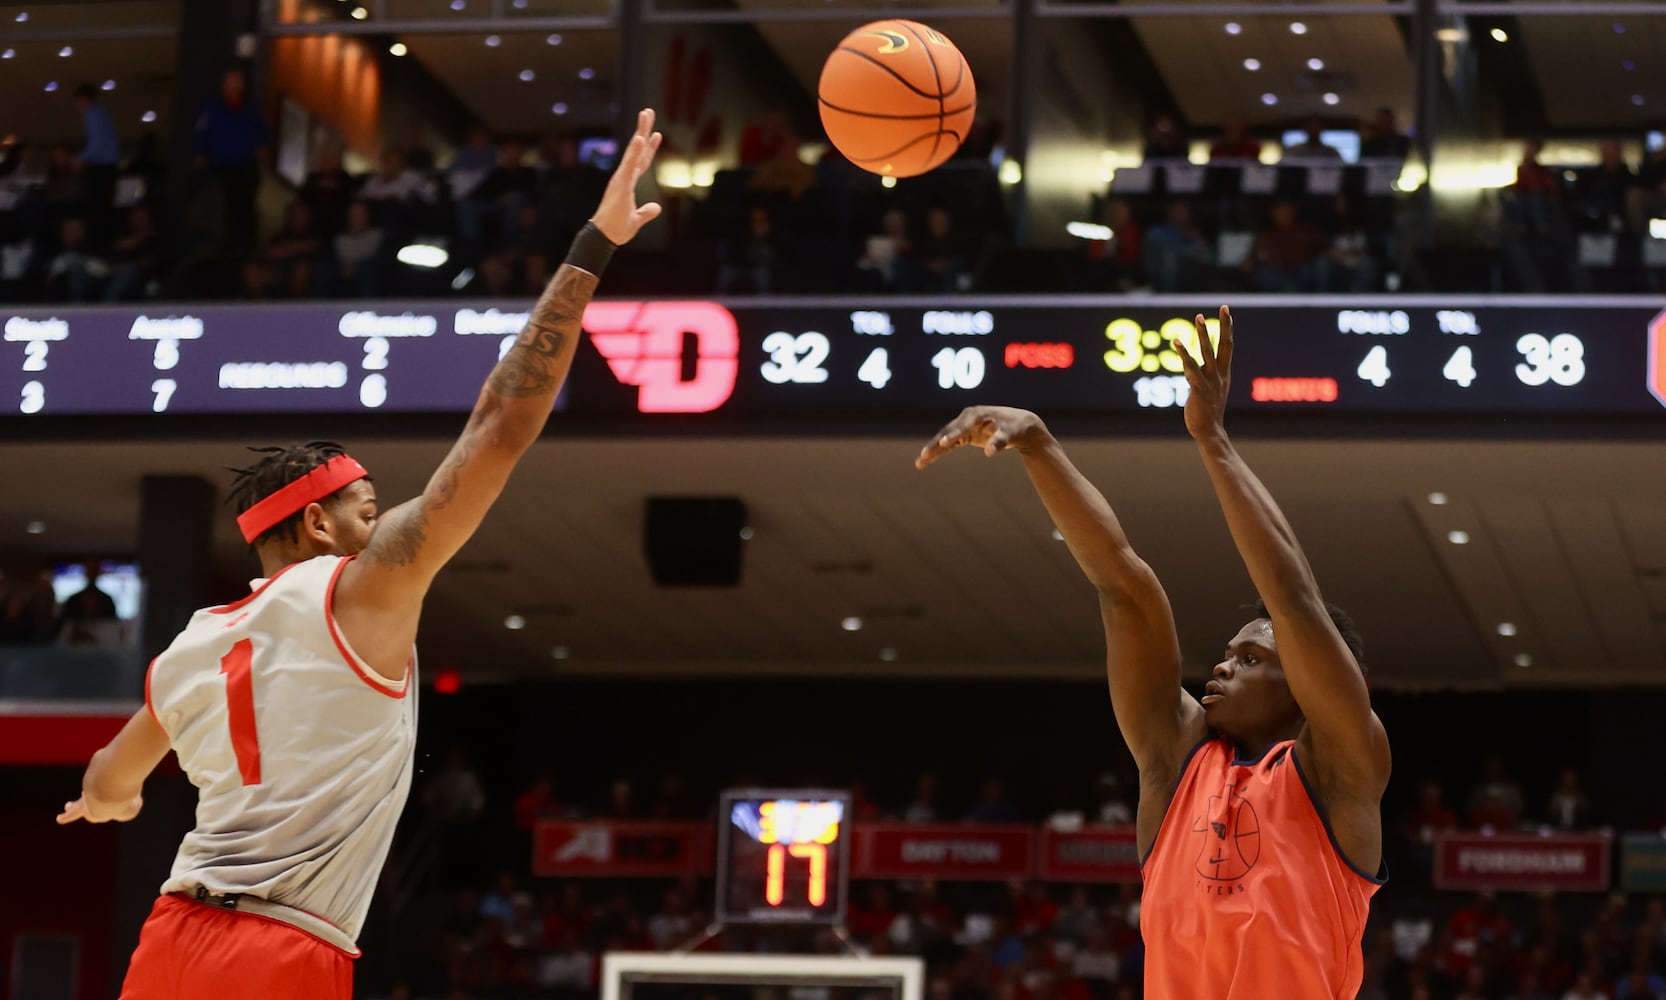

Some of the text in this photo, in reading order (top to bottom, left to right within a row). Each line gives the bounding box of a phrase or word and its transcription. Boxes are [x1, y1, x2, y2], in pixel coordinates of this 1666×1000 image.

[22, 340, 49, 371] 2
[153, 338, 179, 370] 5
[361, 337, 389, 370] 2
[760, 331, 830, 384] 32
[857, 348, 892, 389] 4
[931, 347, 985, 389] 10
[1357, 345, 1391, 388] 4
[1443, 345, 1477, 388] 4
[1515, 333, 1586, 387] 38
[20, 380, 45, 414] 3
[152, 379, 177, 412] 7
[1134, 375, 1191, 407] 1ST
[218, 637, 262, 787] 1
[766, 843, 827, 907] 17
